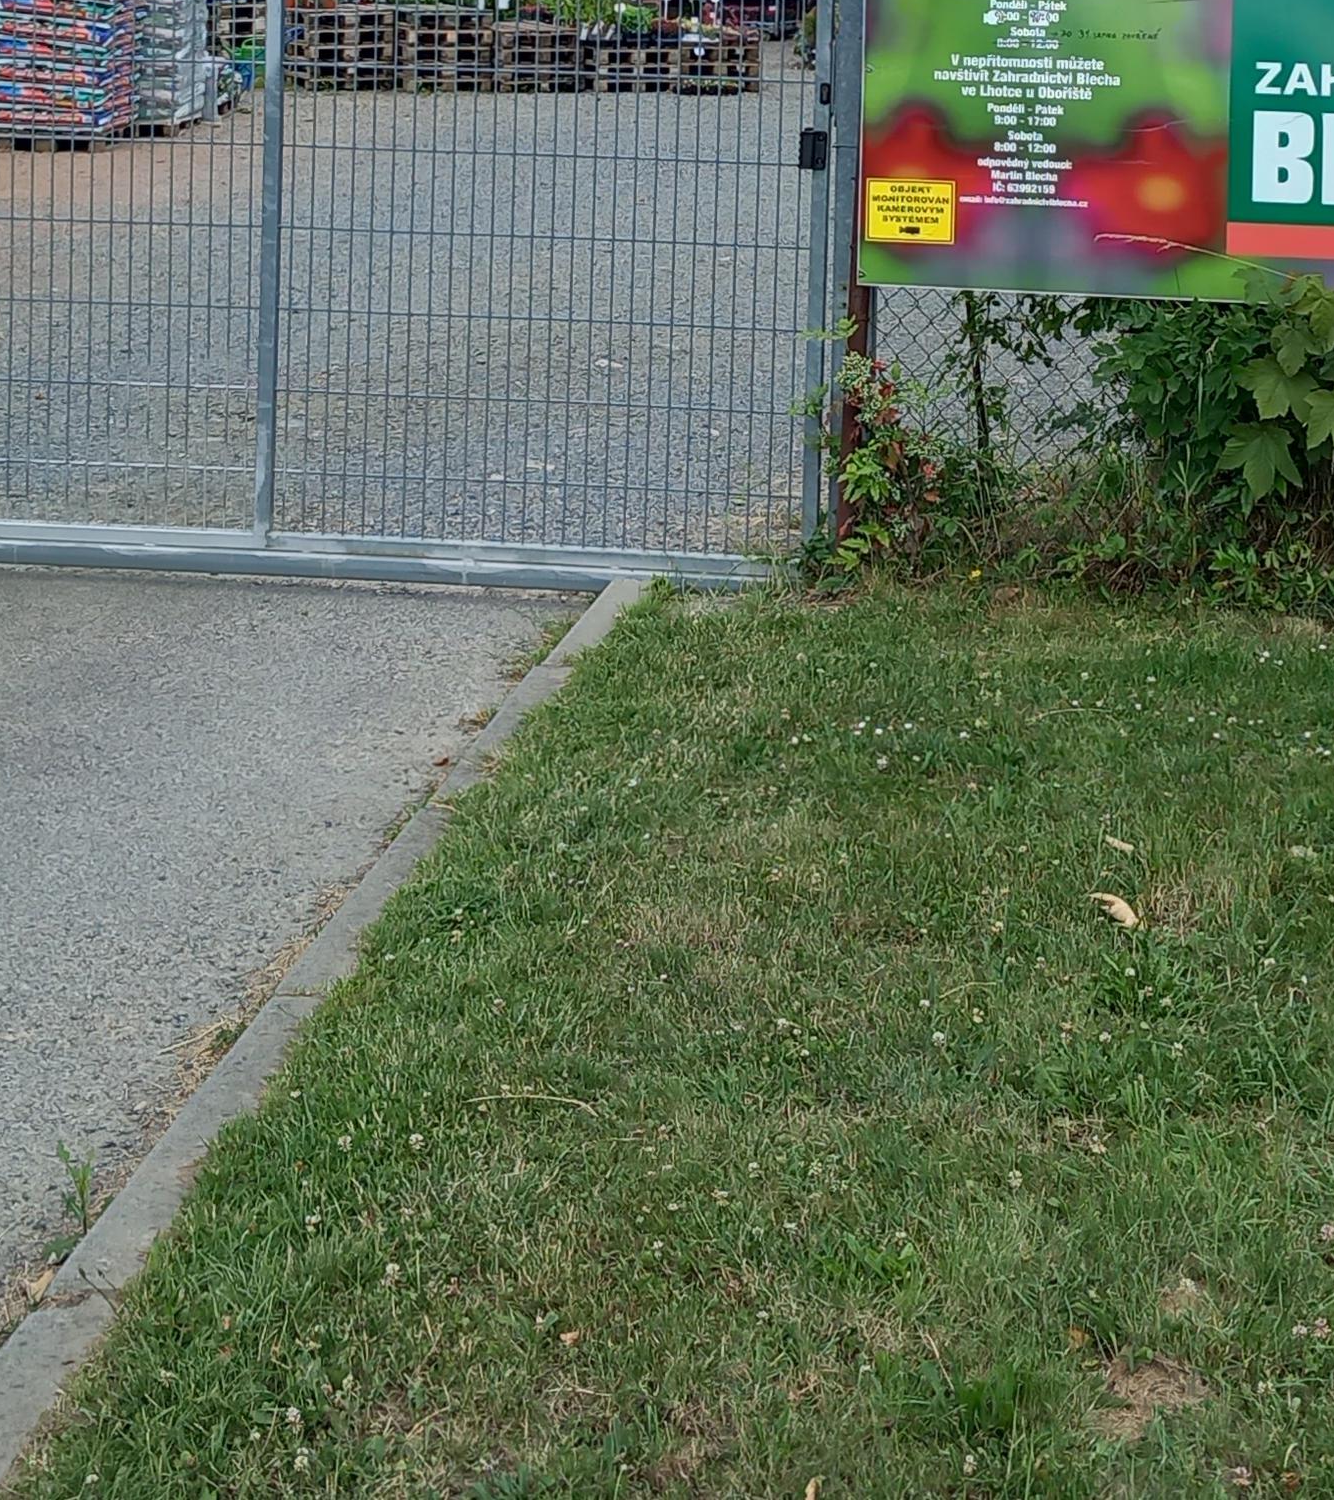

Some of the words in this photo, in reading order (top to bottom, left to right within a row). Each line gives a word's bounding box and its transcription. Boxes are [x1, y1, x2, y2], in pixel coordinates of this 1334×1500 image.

[1038, 0, 1067, 11] Pátek
[1010, 27, 1046, 38] Sobota
[951, 54, 960, 66] V
[1056, 56, 1104, 71] můžete
[1076, 73, 1121, 87] Blecha
[961, 87, 976, 97] ve
[980, 85, 1023, 98] Lhotce
[1026, 88, 1035, 98] u
[994, 115, 1017, 125] 9:00
[1027, 116, 1057, 127] 17:00
[1007, 130, 1043, 141] Sobota
[994, 142, 1017, 152] 8:00
[1027, 143, 1056, 154] 12:00
[991, 170, 1023, 180] Martin
[1025, 171, 1058, 182] Blecha
[890, 185, 932, 194] OBJEKT
